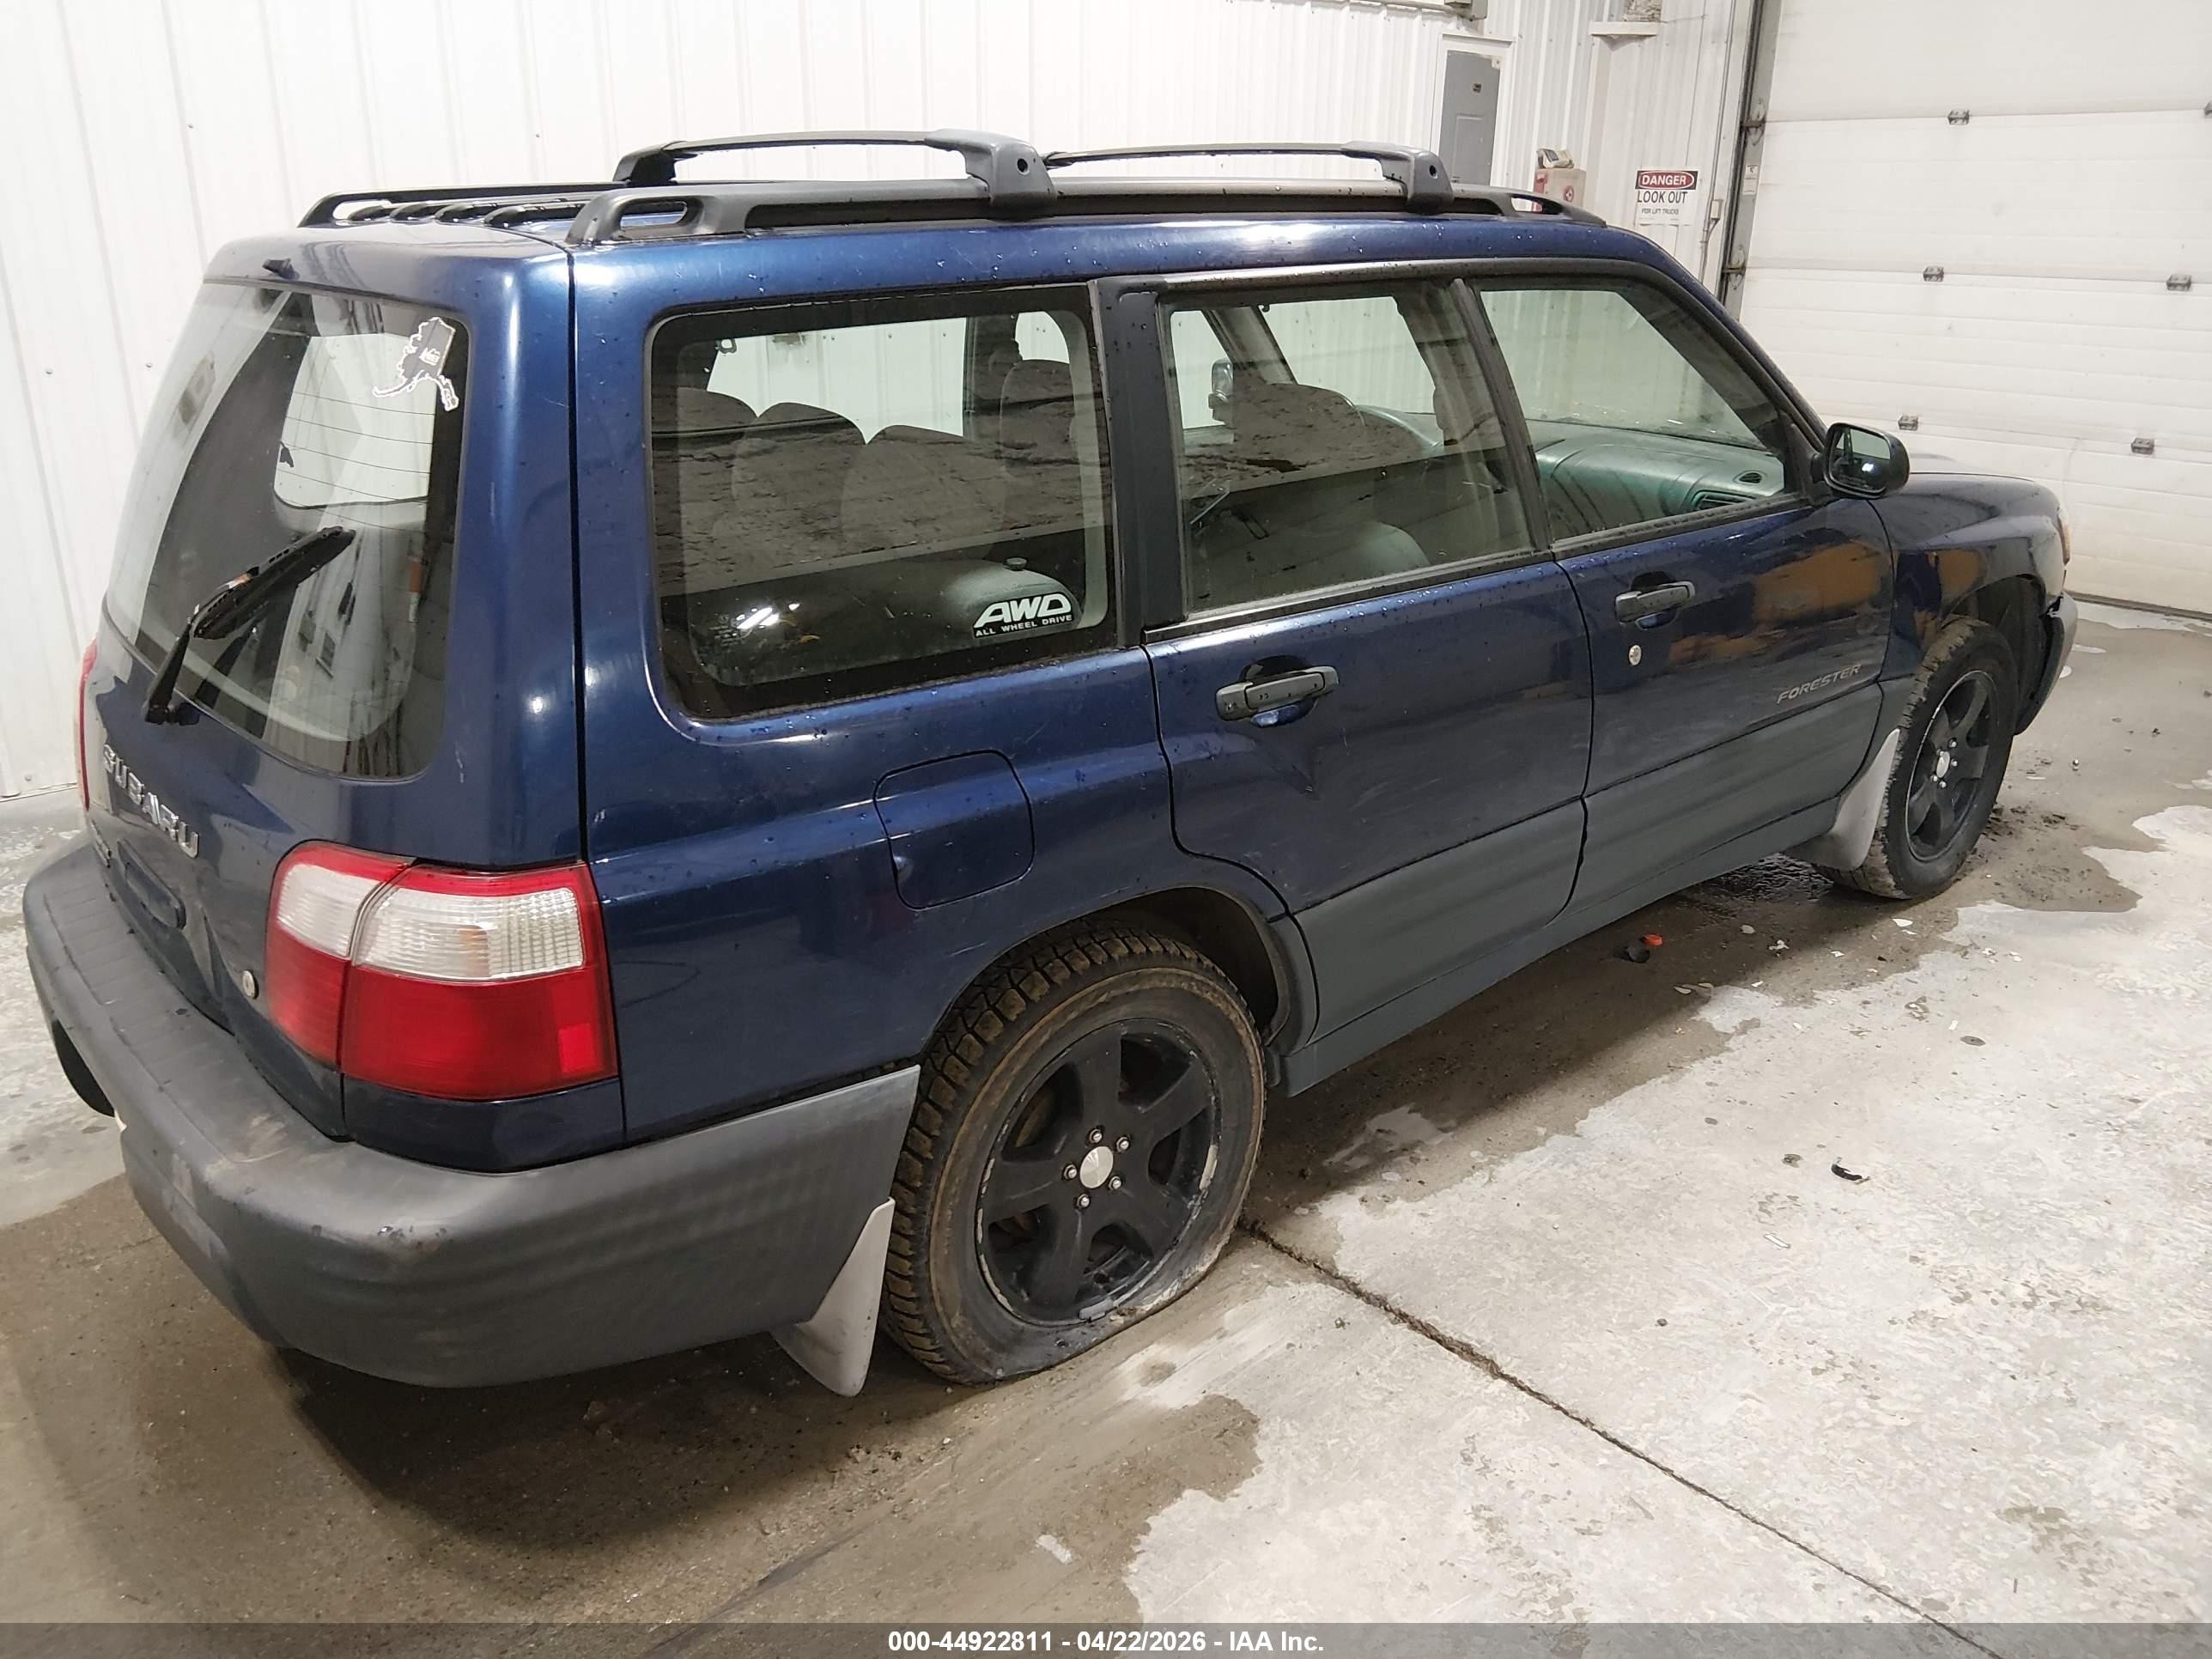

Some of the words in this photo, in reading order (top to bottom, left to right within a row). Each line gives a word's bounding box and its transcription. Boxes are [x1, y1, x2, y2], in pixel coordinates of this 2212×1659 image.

[1642, 174, 1687, 185] DANGER
[1637, 190, 1666, 204] LOOK
[1668, 191, 1688, 204] OUT
[973, 592, 1073, 629] AWD
[975, 628, 996, 637] ALL
[1000, 621, 1038, 633] WHEEL
[1042, 614, 1073, 626] DRIVE
[1776, 663, 1863, 704] FORESTER
[103, 744, 199, 859] SUBARU
